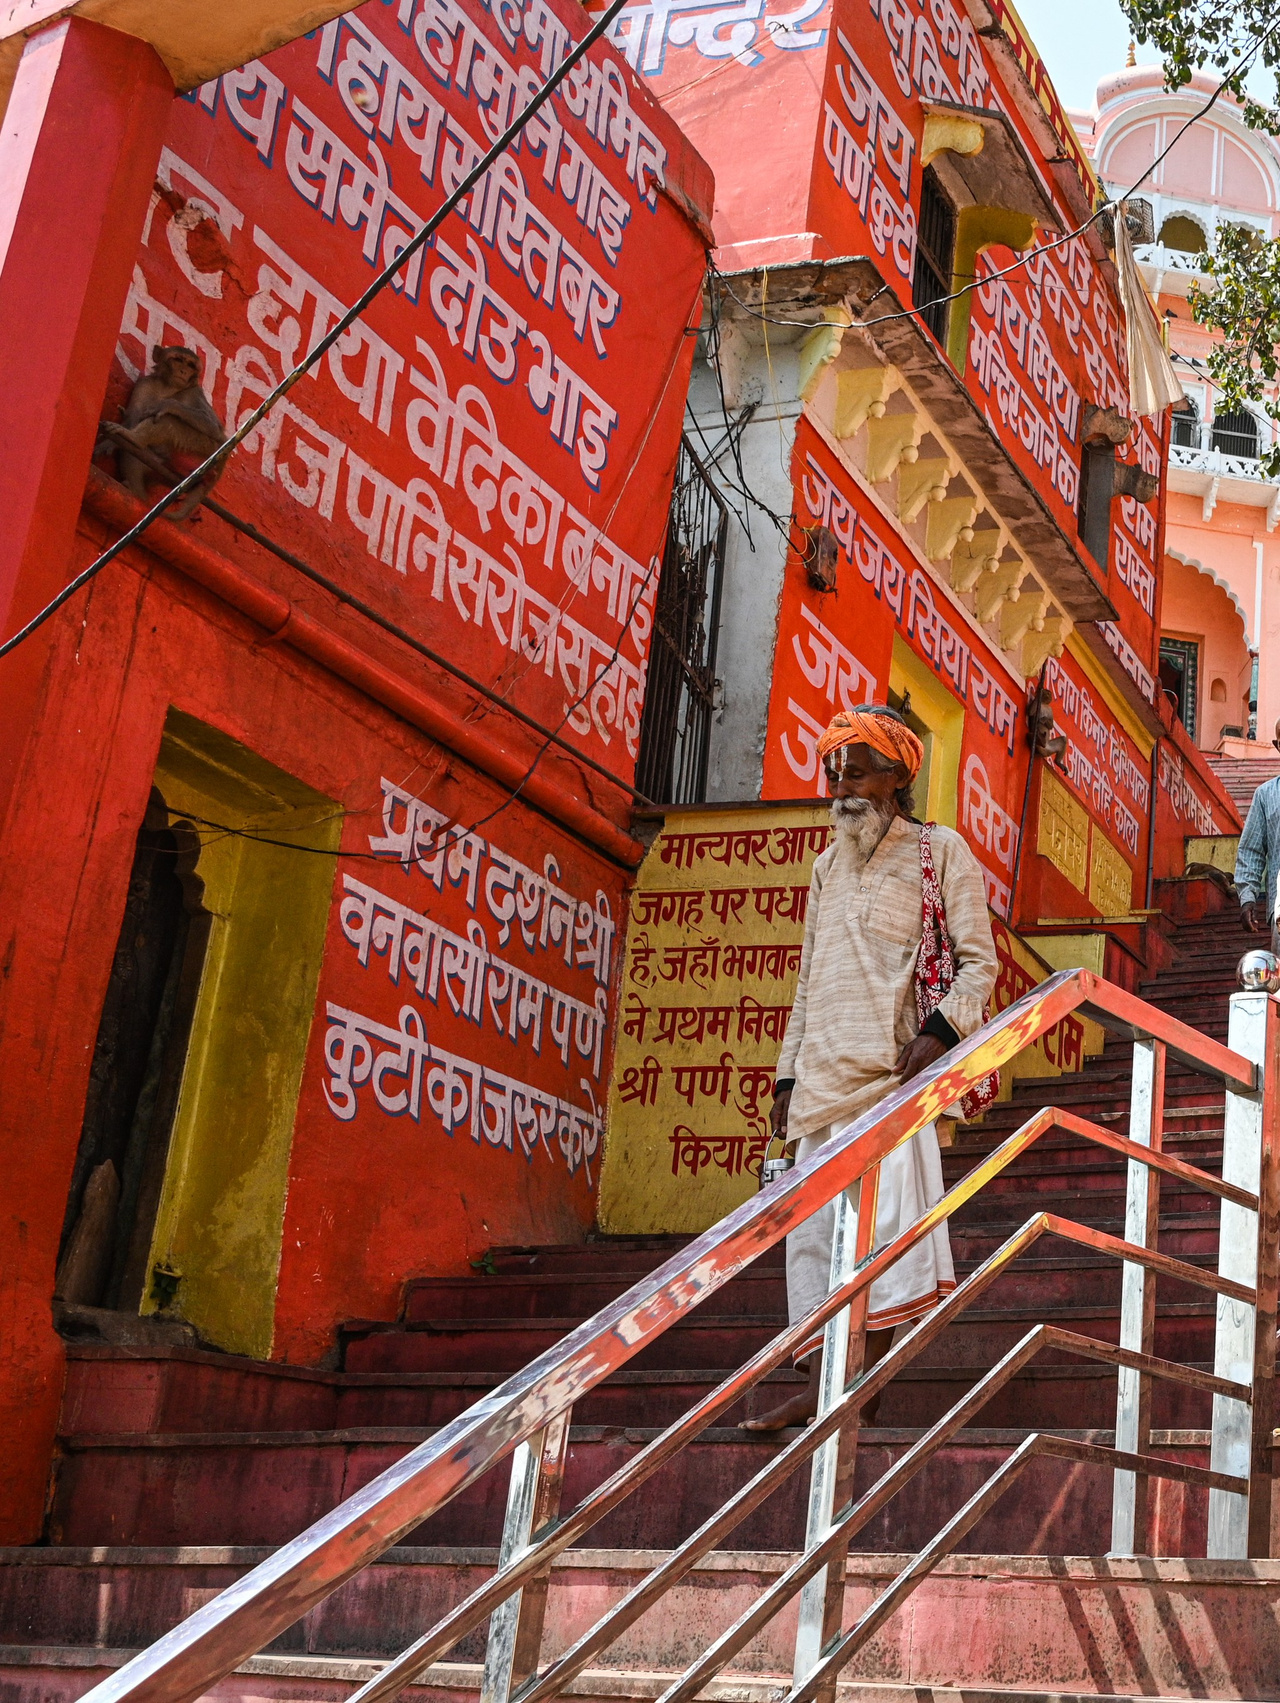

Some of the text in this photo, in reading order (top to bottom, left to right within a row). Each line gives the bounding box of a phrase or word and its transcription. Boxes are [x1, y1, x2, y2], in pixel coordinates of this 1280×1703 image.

[286, 98, 437, 305] समेत
[430, 233, 529, 384] दोउ
[527, 330, 619, 491] भाइ
[559, 248, 622, 358] बर
[835, 26, 1157, 562] जय सिया राम
[974, 249, 1030, 374] जय
[406, 335, 567, 570] वेदिका
[345, 448, 452, 602] पानि
[447, 530, 561, 678] सरोज
[801, 451, 1020, 757] जय जय सिया राम
[1112, 523, 1156, 621] रास्ता
[791, 602, 879, 705] जय
[367, 775, 616, 989] प्रथम दर्शन श्री
[658, 829, 770, 870] मान्यवर
[632, 886, 810, 934] जगह पर पधा
[658, 936, 721, 990] जहाँ
[338, 872, 608, 1084] वनवासी राम पर्ण
[623, 992, 793, 1045] ने प्रथम निवा
[321, 1000, 431, 1125] कुटी
[617, 1055, 663, 1107] श्री
[670, 1051, 734, 1107] पर्ण
[668, 1124, 748, 1178] किया
